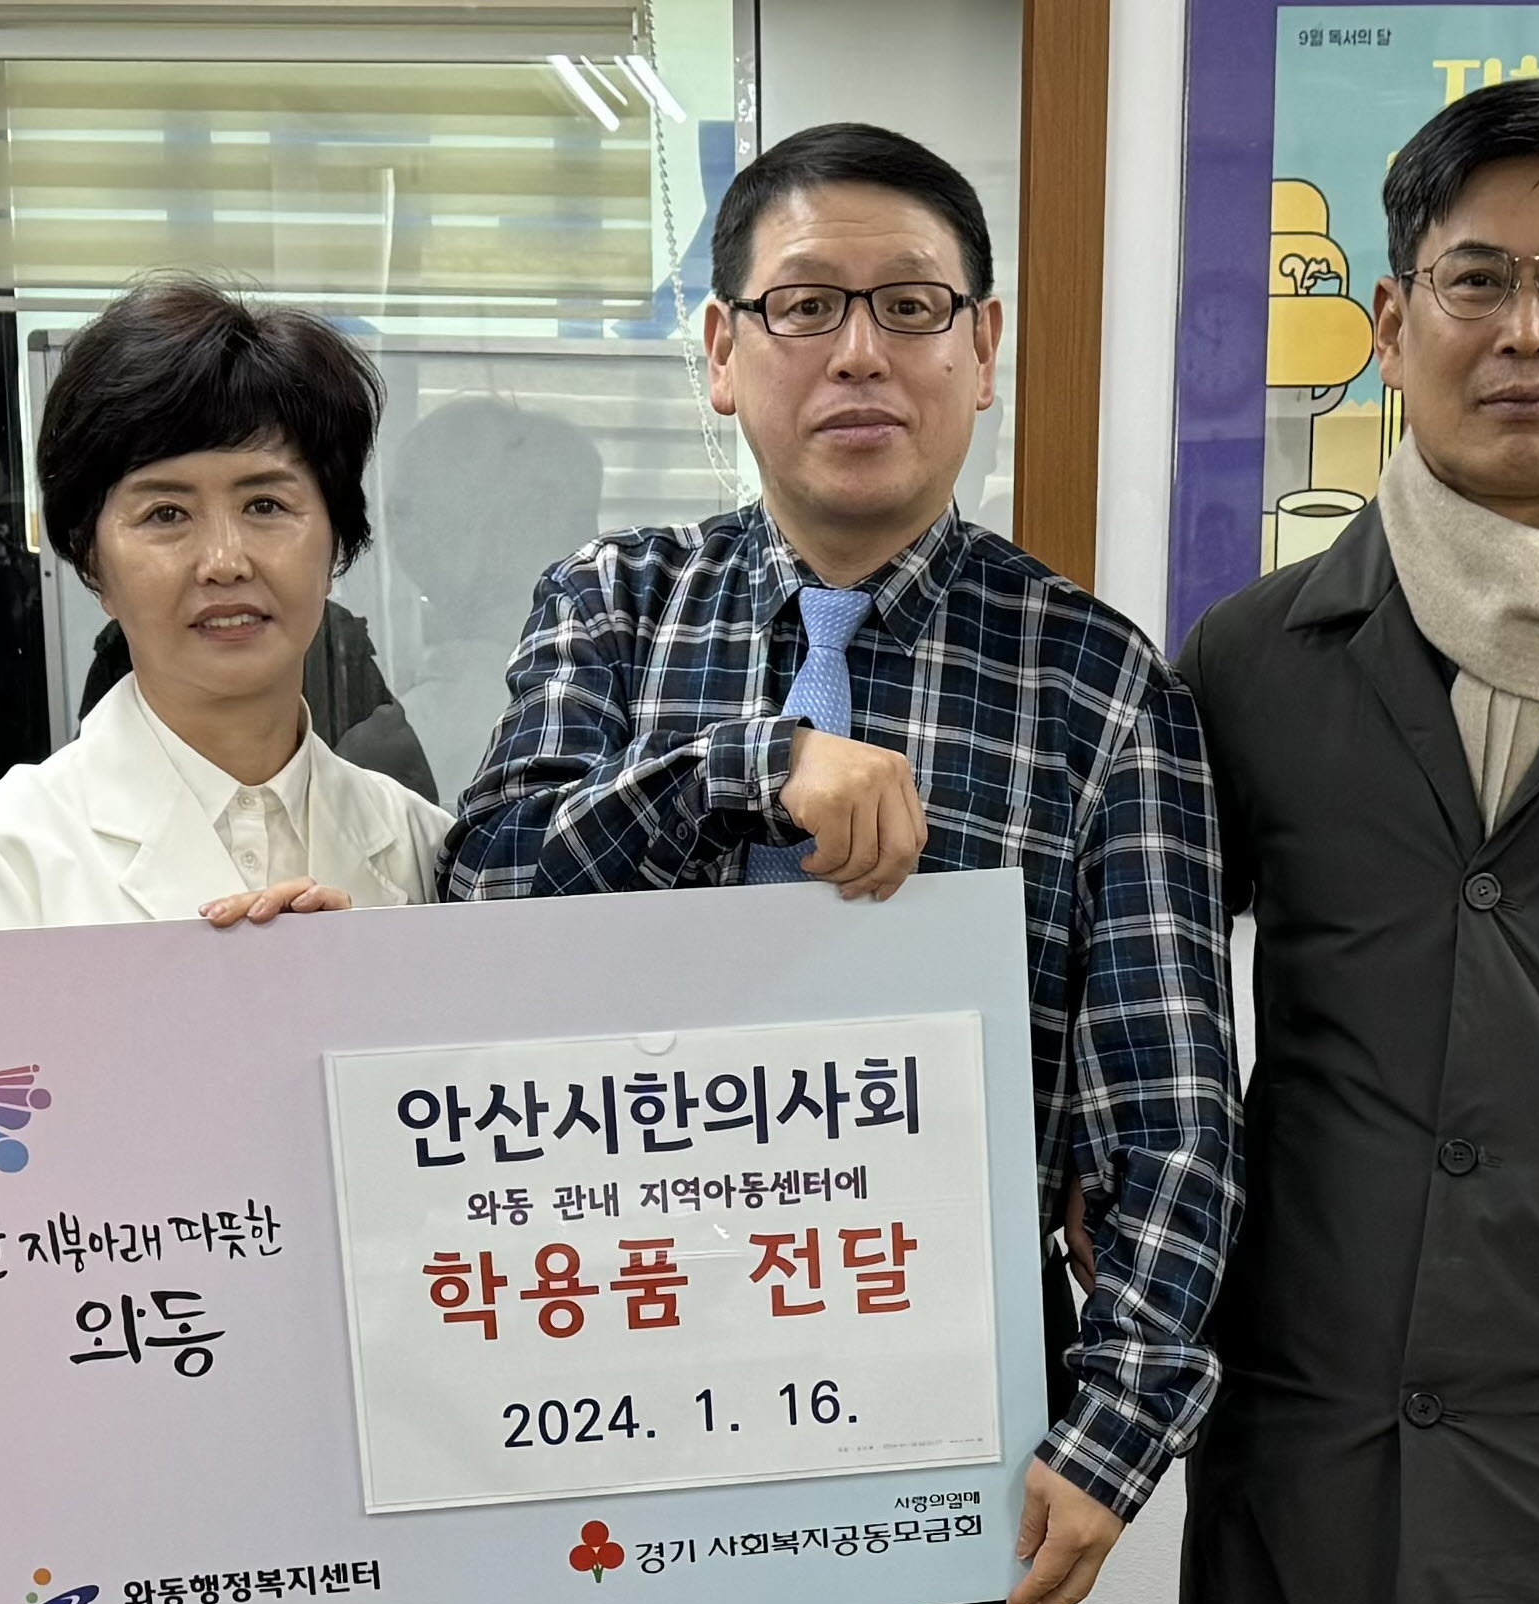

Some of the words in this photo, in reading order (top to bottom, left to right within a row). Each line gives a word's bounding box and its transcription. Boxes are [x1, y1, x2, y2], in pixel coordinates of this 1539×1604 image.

[1299, 29, 1323, 47] 9월
[1329, 28, 1372, 47] 독서의
[1377, 28, 1392, 47] 달
[396, 1055, 922, 1168] 안산시한의사회
[466, 1186, 534, 1227] 와동
[552, 1180, 620, 1219] 관내
[640, 1166, 869, 1213] 지역아동센터에
[19, 1210, 161, 1272] 지붕아래
[167, 1198, 284, 1262] 따뜻한
[422, 1236, 692, 1342] 학용품
[748, 1220, 919, 1319] 전달
[69, 1291, 225, 1377] 와동
[502, 1394, 657, 1448] 2024.
[695, 1387, 741, 1433] 1.
[778, 1379, 859, 1428] 16.
[636, 1540, 697, 1575] 경기
[708, 1514, 983, 1558] 사회복지공동모금회
